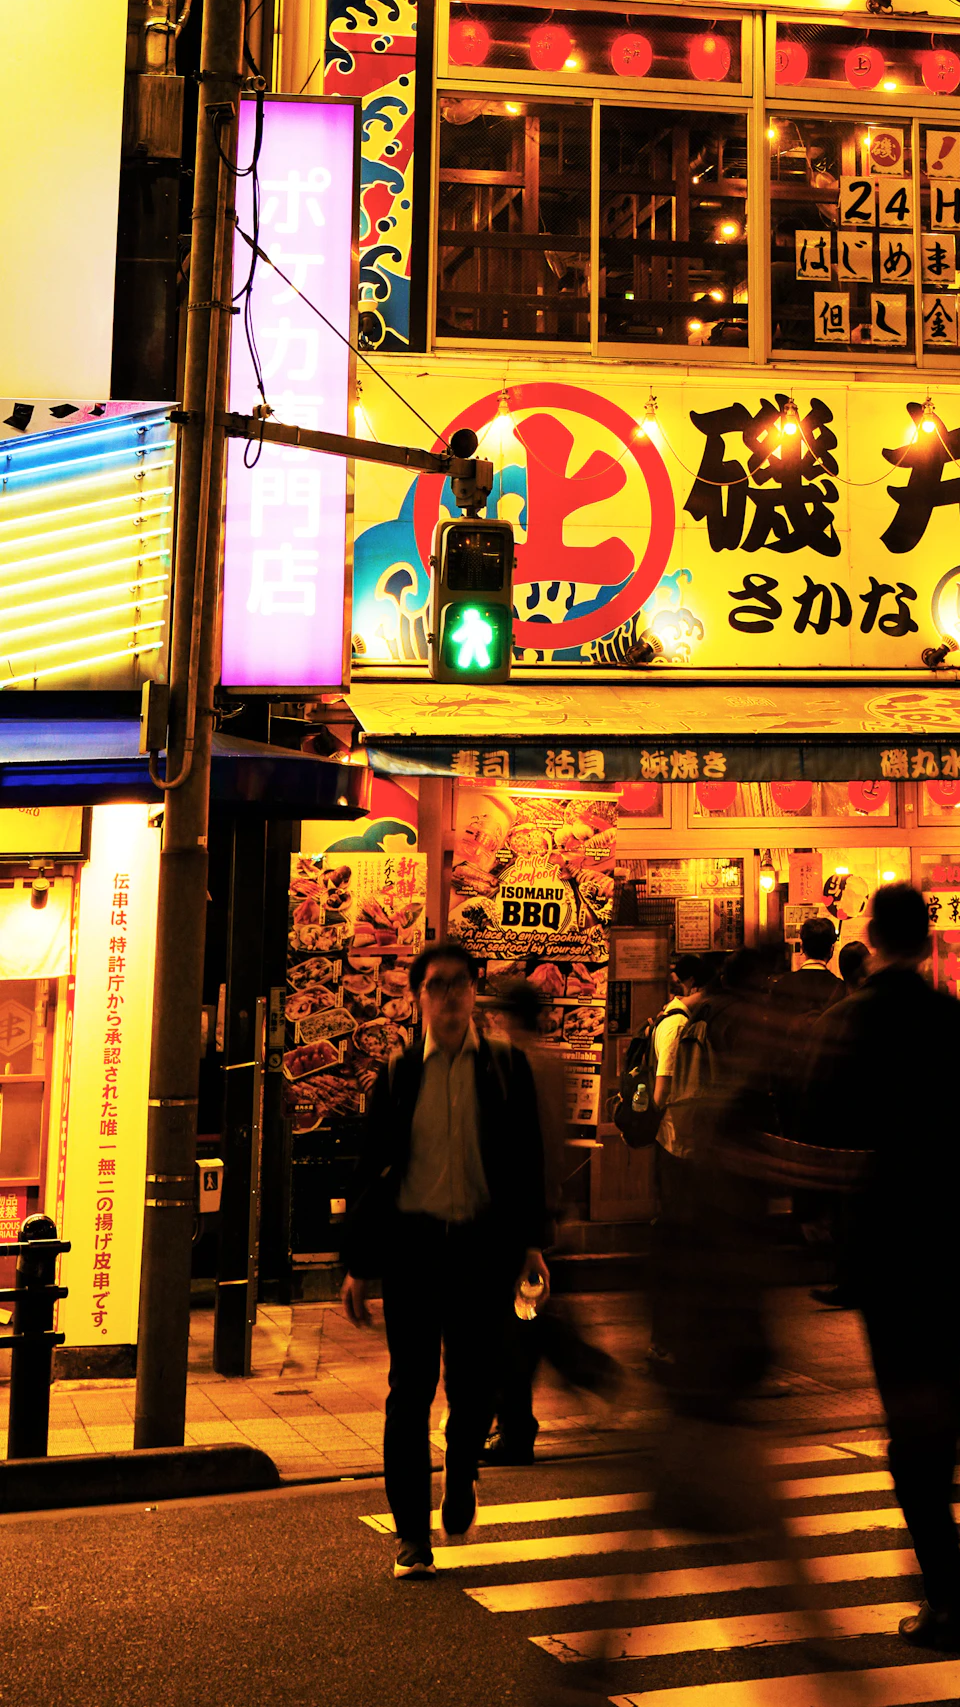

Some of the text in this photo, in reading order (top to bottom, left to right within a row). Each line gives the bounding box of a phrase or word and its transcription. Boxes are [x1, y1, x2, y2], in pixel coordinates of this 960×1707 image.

[841, 181, 960, 226] 24H
[450, 749, 511, 780] 寿司
[544, 749, 606, 780] 活貝
[639, 749, 728, 780] 浜焼き
[514, 854, 550, 869] Grilled
[397, 857, 420, 904] 新鮮
[508, 866, 560, 886] Seafood
[500, 886, 564, 901] ISOMARU
[501, 900, 561, 930] BBQ
[464, 929, 588, 945] A place to enjoy cooking
[487, 940, 530, 953] seafood
[531, 940, 544, 955] by
[546, 943, 593, 955] yourself.
[90, 871, 130, 1338] 伝串は、特許庁から承認された唯一無二の揚げ皮串です。
